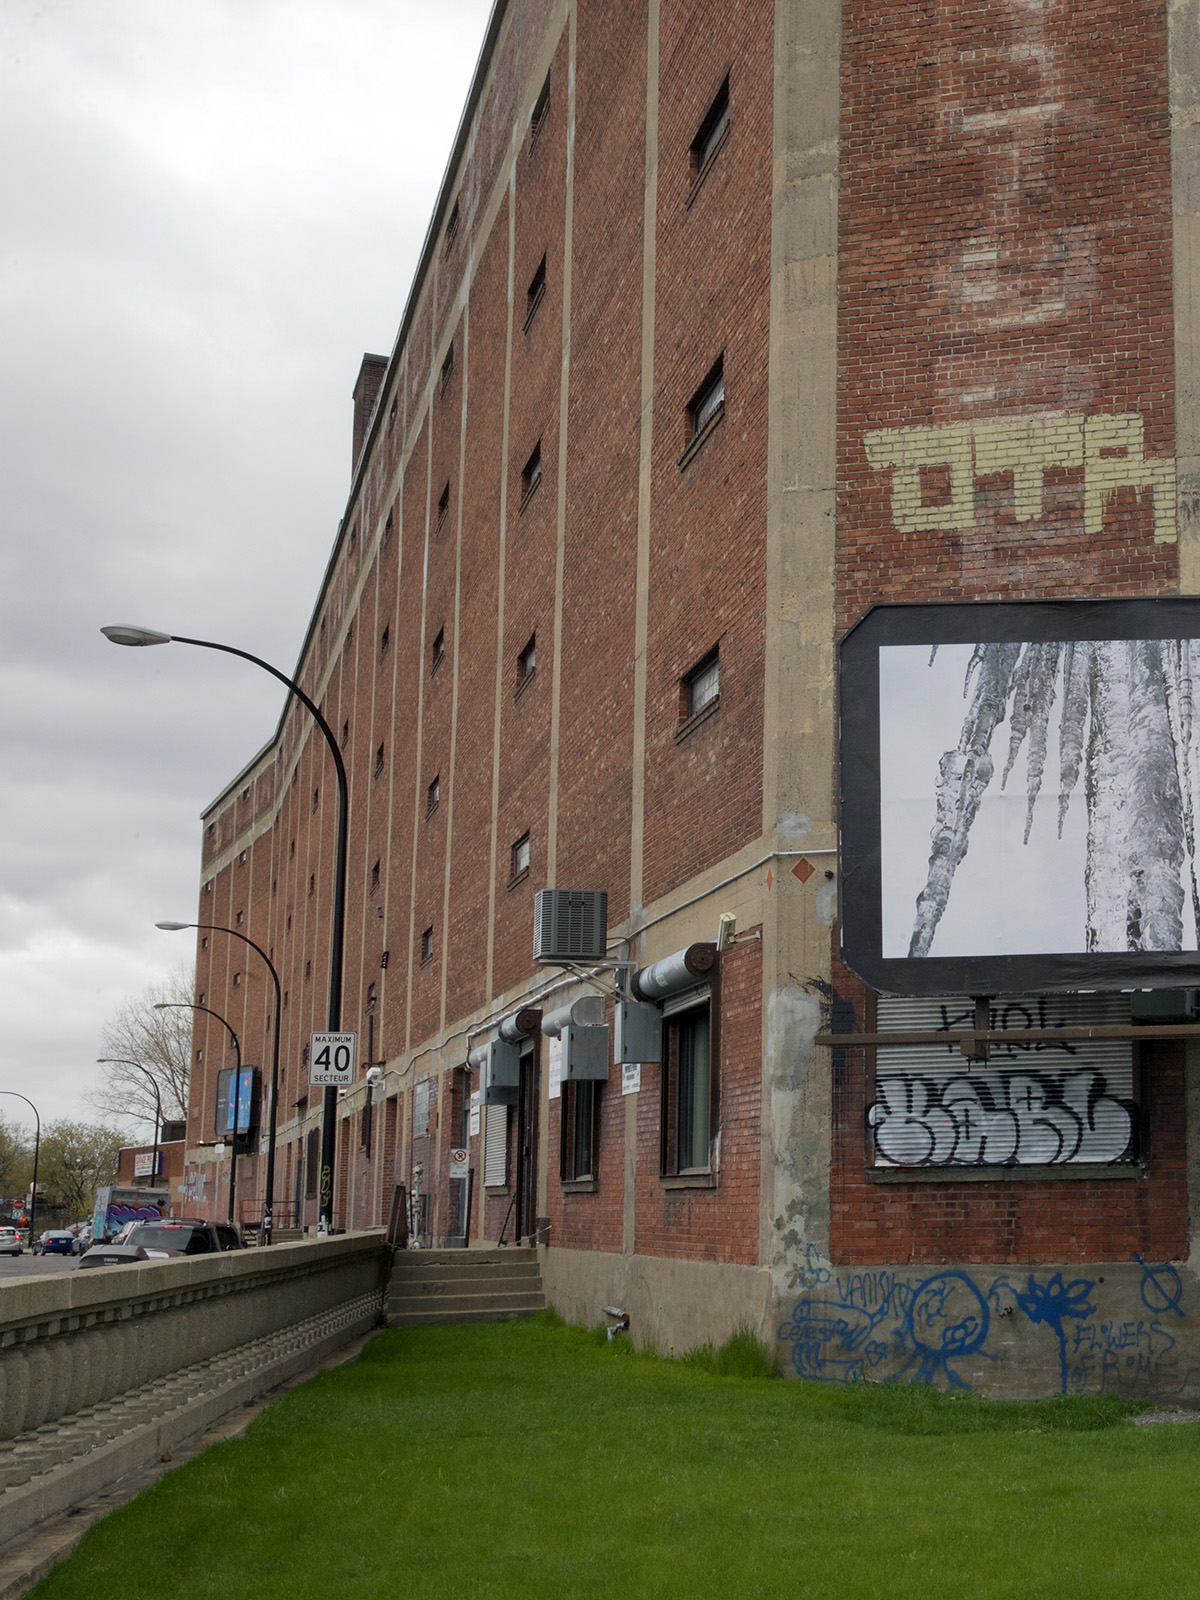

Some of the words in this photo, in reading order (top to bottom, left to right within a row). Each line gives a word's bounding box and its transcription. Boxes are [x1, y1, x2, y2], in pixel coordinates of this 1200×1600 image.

[314, 1035, 352, 1044] MAXIMUM
[314, 1045, 351, 1072] 40
[314, 1074, 349, 1083] SECTEUR
